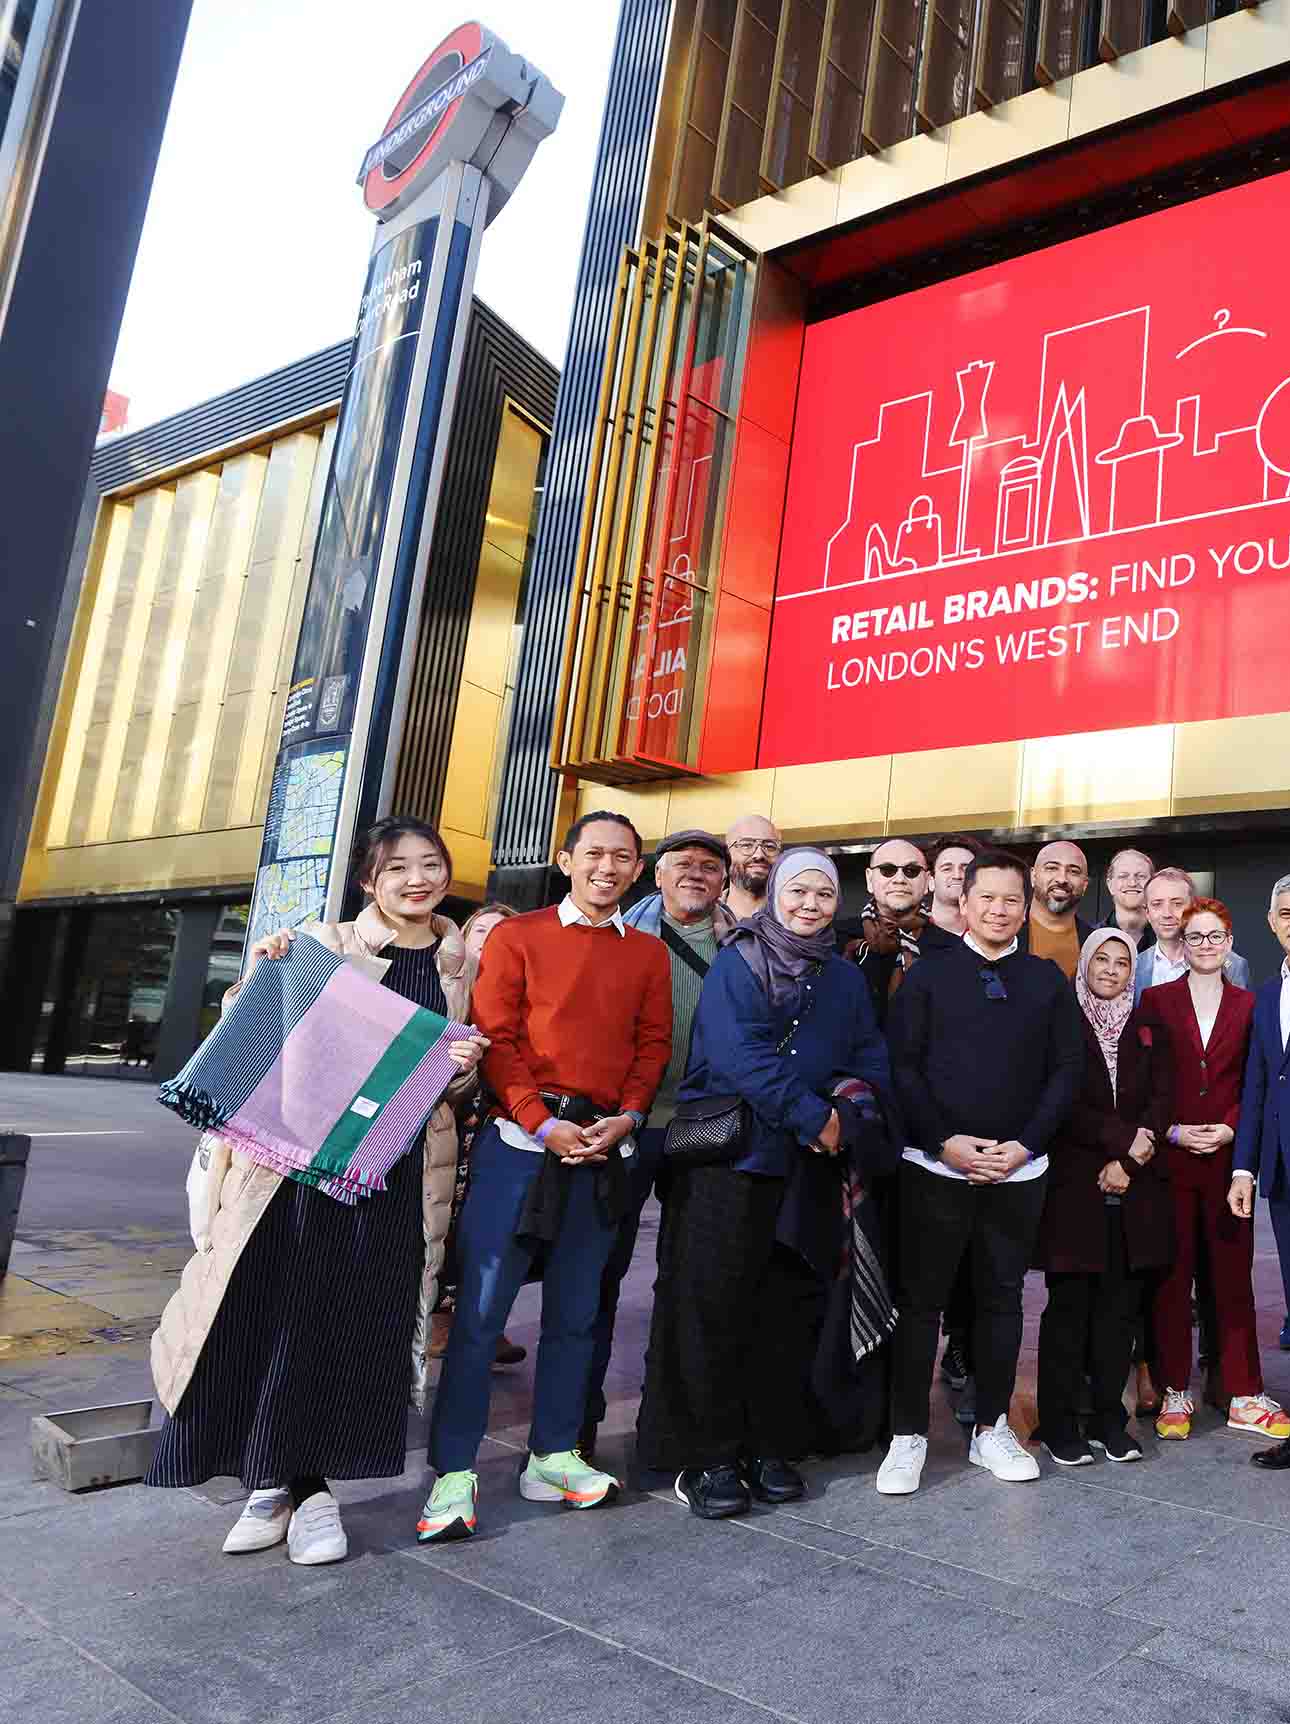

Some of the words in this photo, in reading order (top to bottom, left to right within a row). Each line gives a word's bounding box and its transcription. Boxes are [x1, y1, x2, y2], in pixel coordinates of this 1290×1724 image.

[367, 58, 488, 166] UNDERGROUND
[383, 279, 420, 313] Rad
[831, 600, 934, 644] RETAIL
[943, 571, 1099, 625] BRANDS:
[1109, 553, 1196, 597] FIND
[827, 638, 985, 690] LONDON'S
[995, 621, 1090, 665] WEST
[1101, 607, 1180, 649] END
